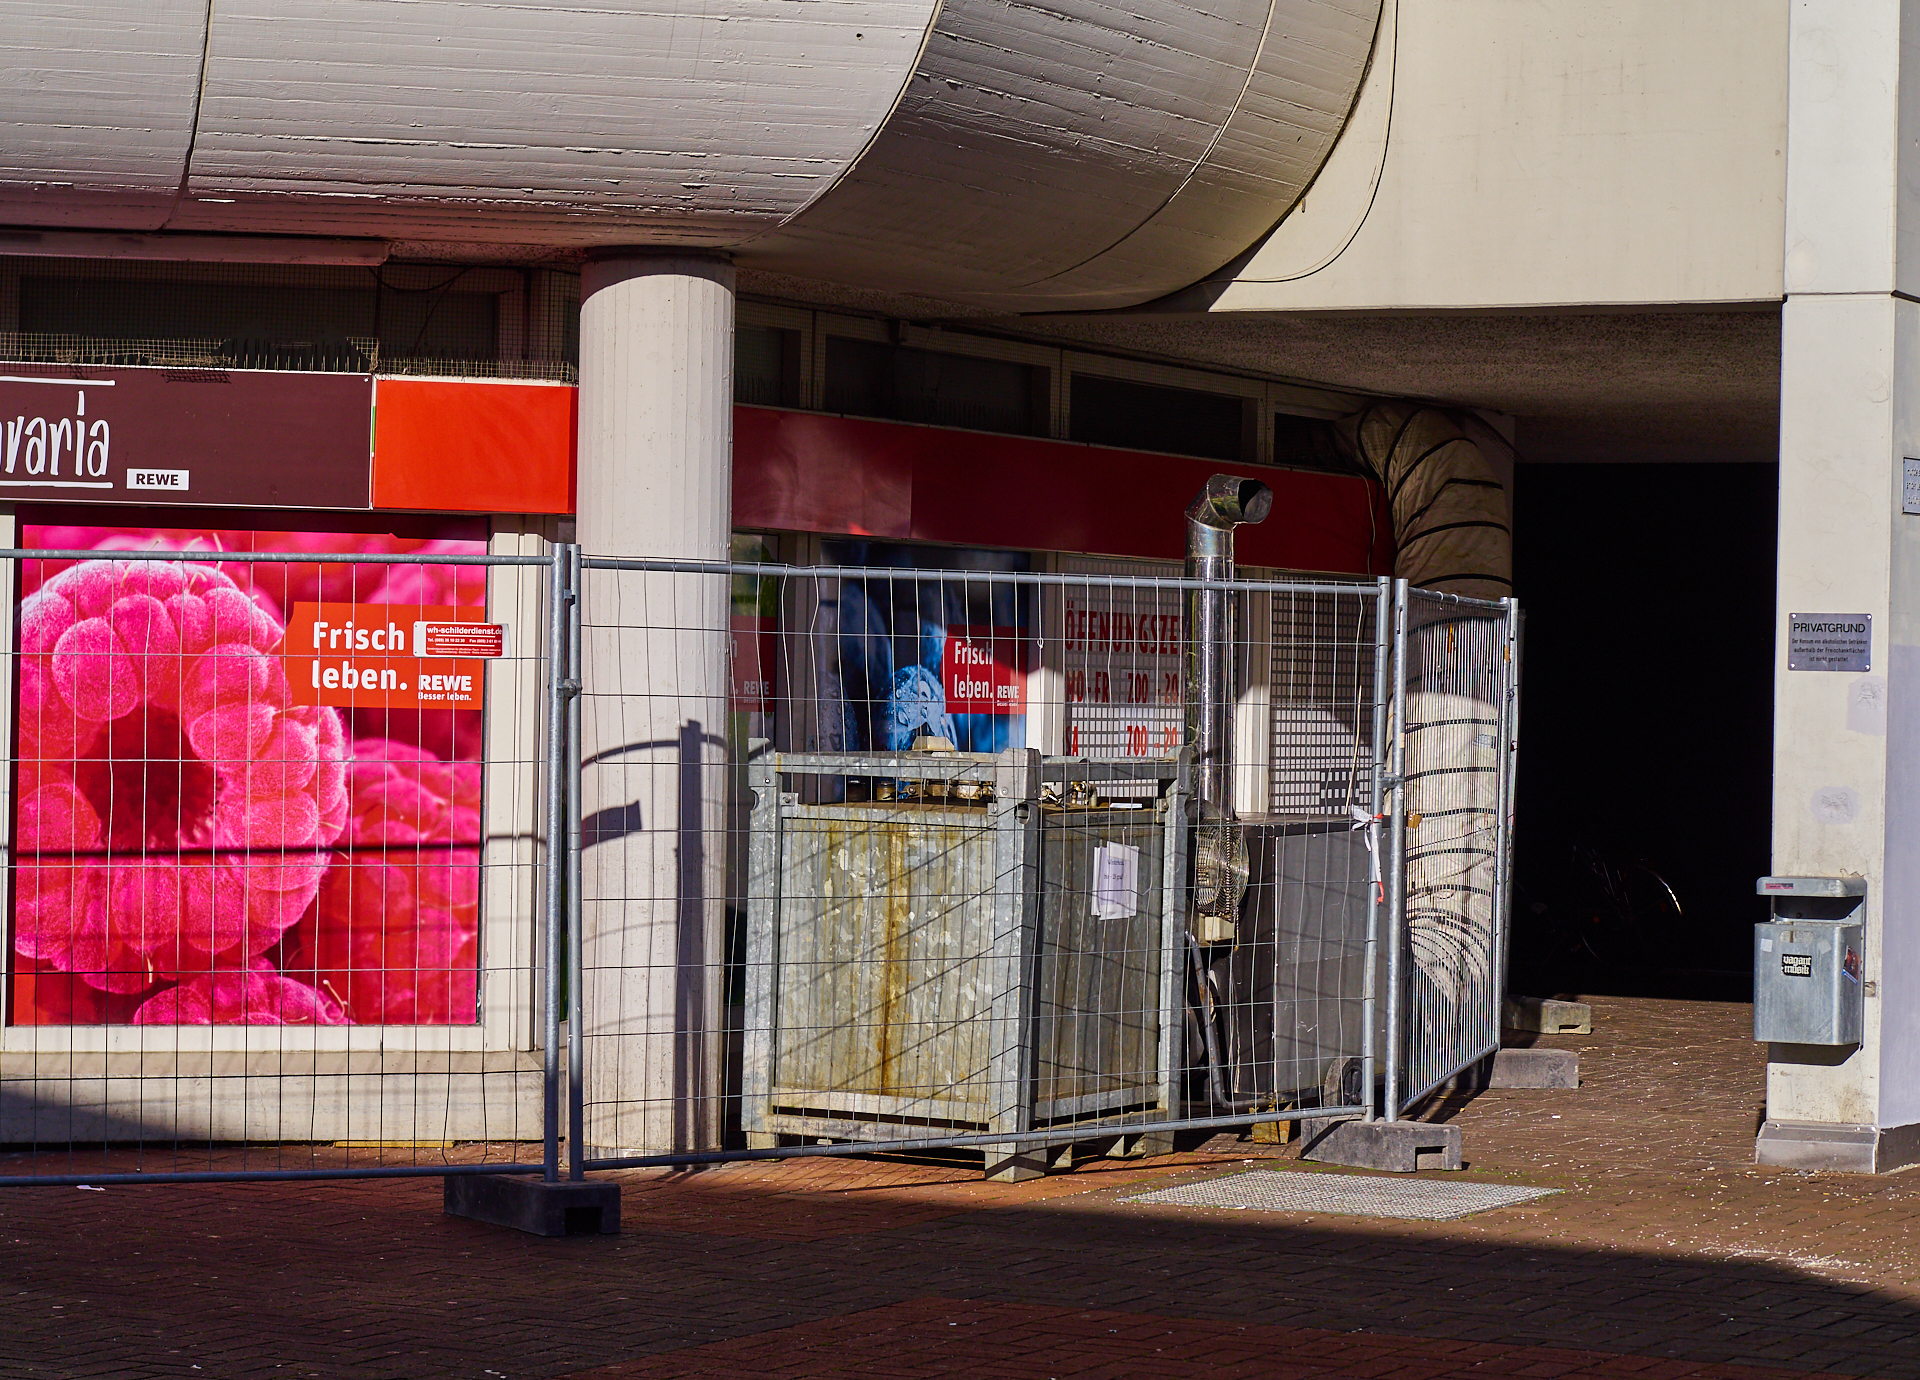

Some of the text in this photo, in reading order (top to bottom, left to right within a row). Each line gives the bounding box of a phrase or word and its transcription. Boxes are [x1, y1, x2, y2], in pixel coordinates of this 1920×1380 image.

[0, 390, 110, 477] varia
[136, 473, 179, 486] REWE
[427, 626, 502, 635] wh-schilderdienst.de
[1793, 622, 1866, 633] PRIVATGRUND
[313, 621, 405, 651] Frisch
[955, 641, 992, 665] Frisch
[312, 660, 408, 690] leben.
[418, 675, 472, 691] REWE
[954, 674, 994, 698] leben.
[997, 685, 1019, 698] REWE
[418, 691, 472, 701] Besser leben.
[1065, 725, 1079, 757] SA
[1783, 955, 1811, 966] vagant
